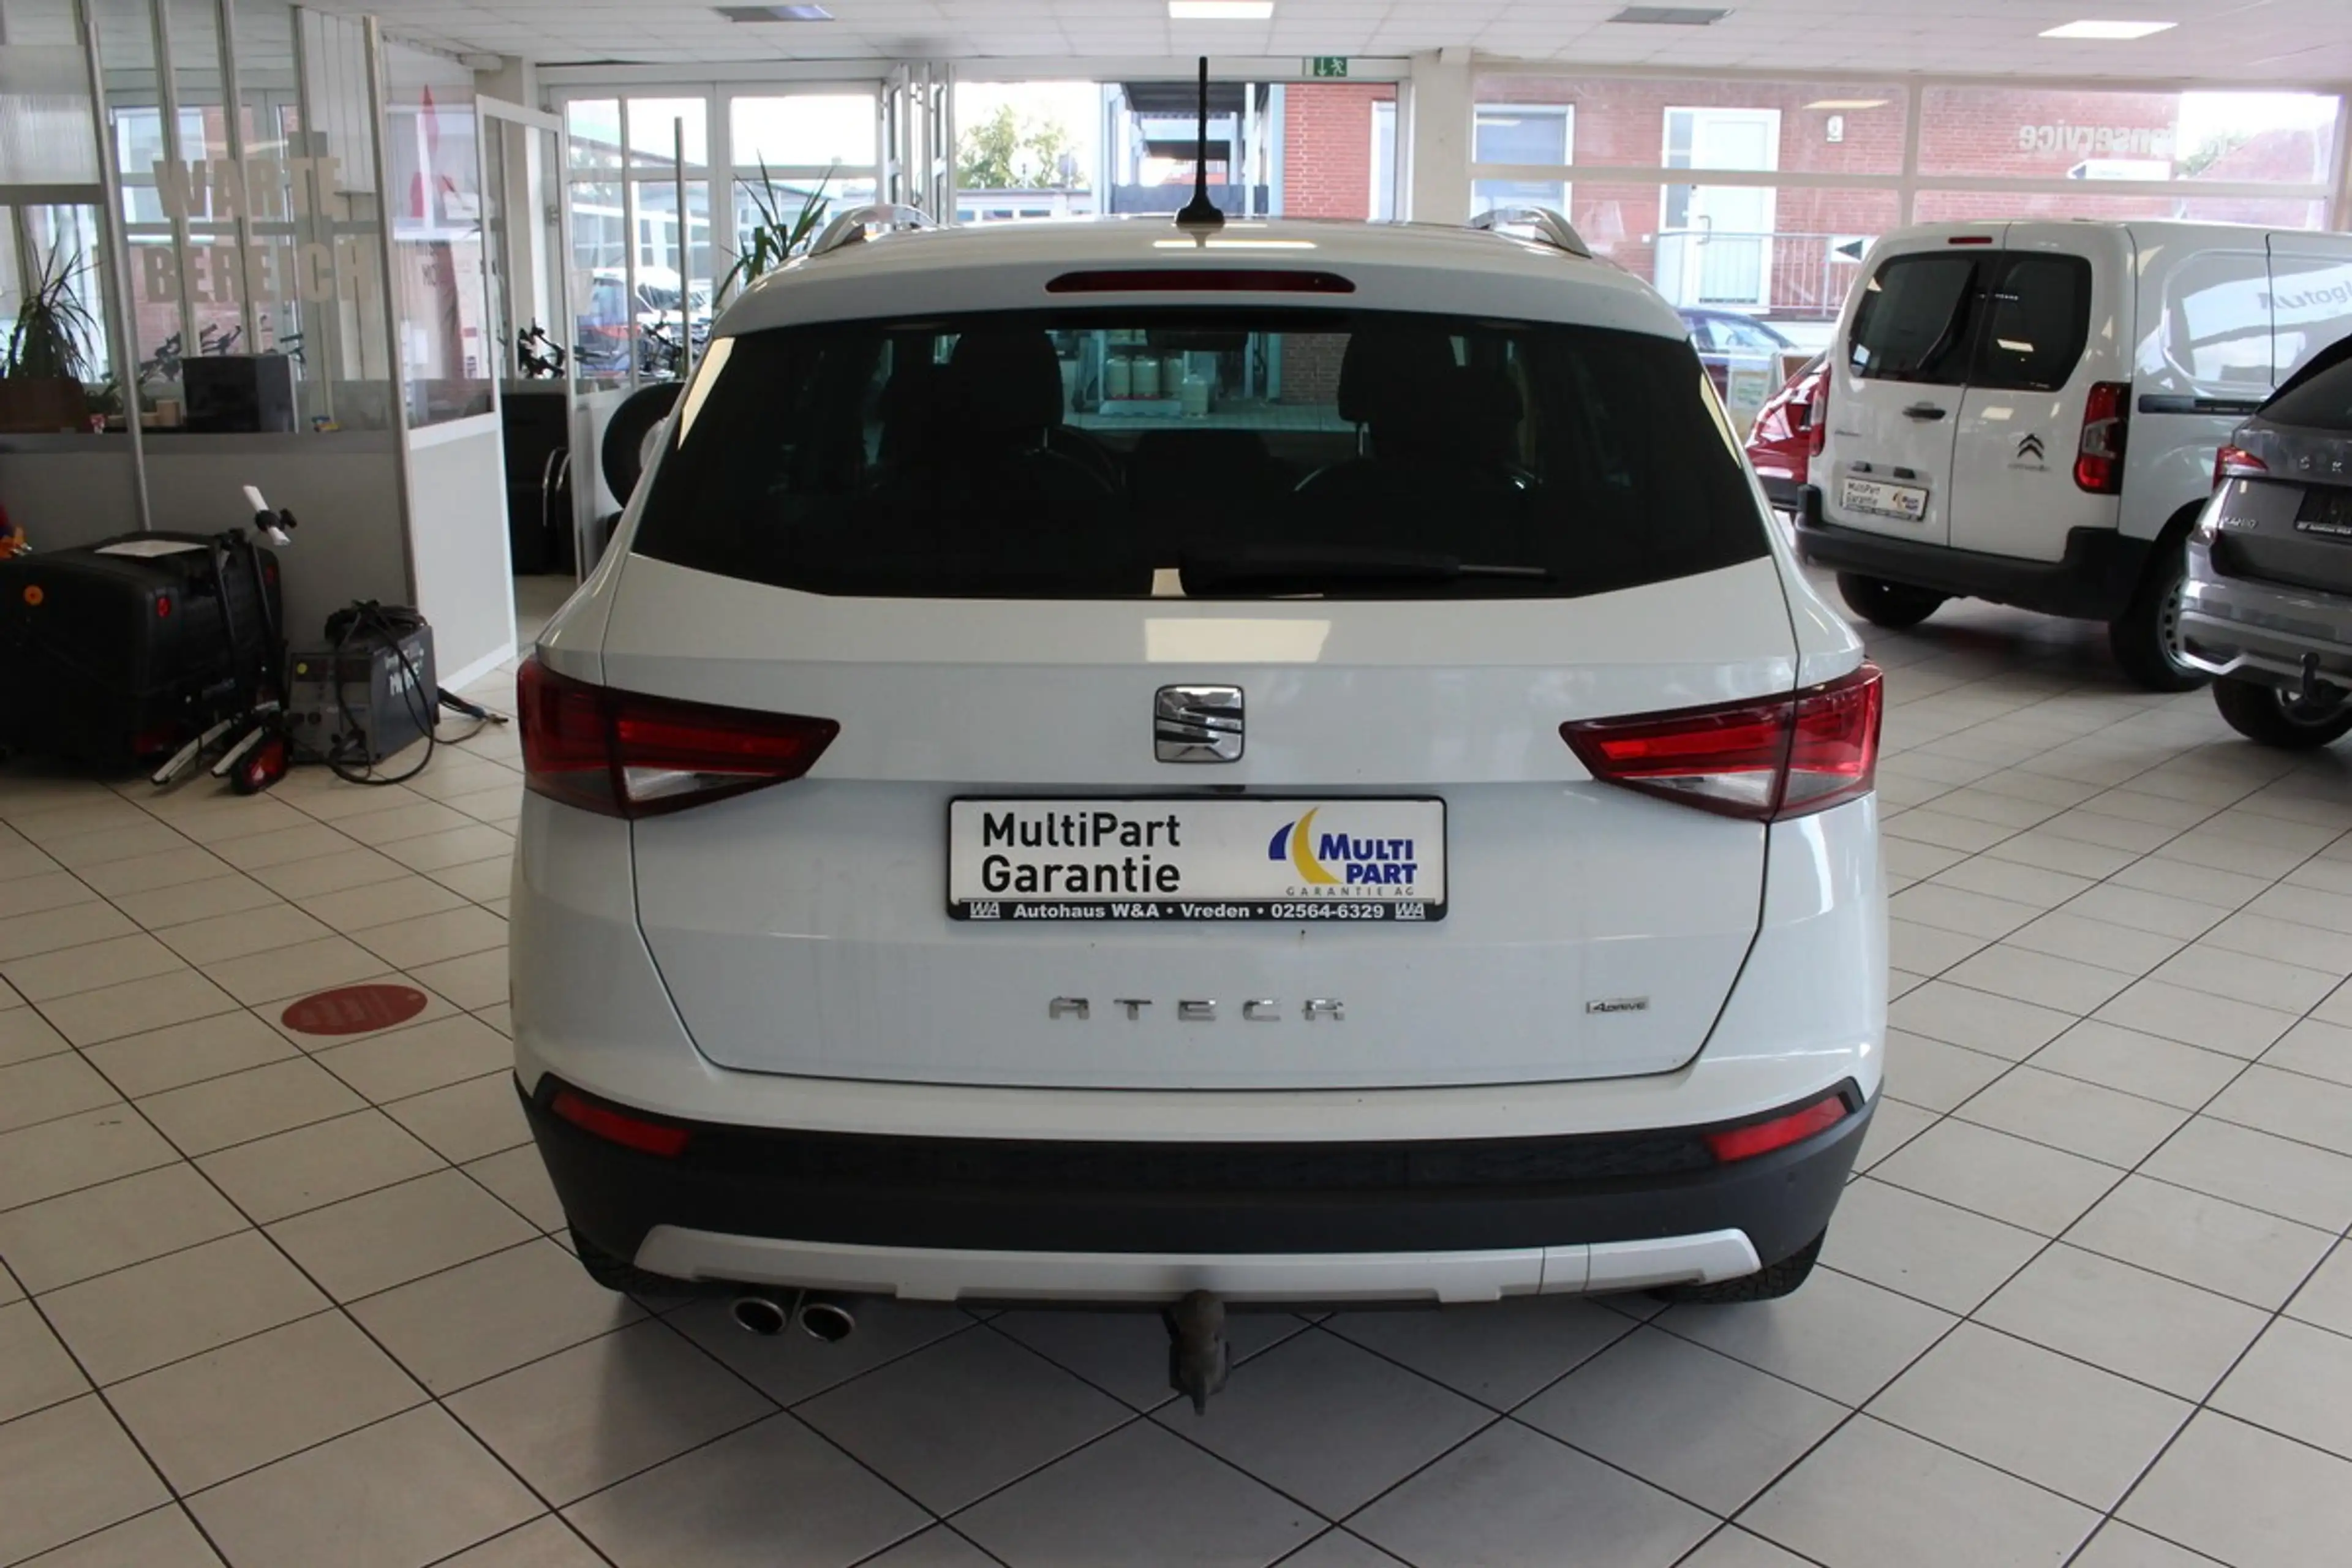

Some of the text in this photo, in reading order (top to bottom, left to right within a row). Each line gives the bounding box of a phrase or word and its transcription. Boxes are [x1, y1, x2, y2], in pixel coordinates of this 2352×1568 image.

[153, 157, 342, 217] WARTE
[143, 243, 372, 303] BEREICH
[983, 812, 1180, 847] MultiPart
[1318, 833, 1414, 861] MULTI
[982, 854, 1181, 893] Garantie
[1346, 863, 1418, 884] PART
[1286, 886, 1414, 896] GARANTIE AG
[1013, 903, 1106, 918] Autohaus
[1111, 903, 1159, 918] W&A
[1180, 903, 1250, 918] Vreden
[1271, 903, 1384, 918] 02564-6329
[1048, 997, 1345, 1021] ATECA
